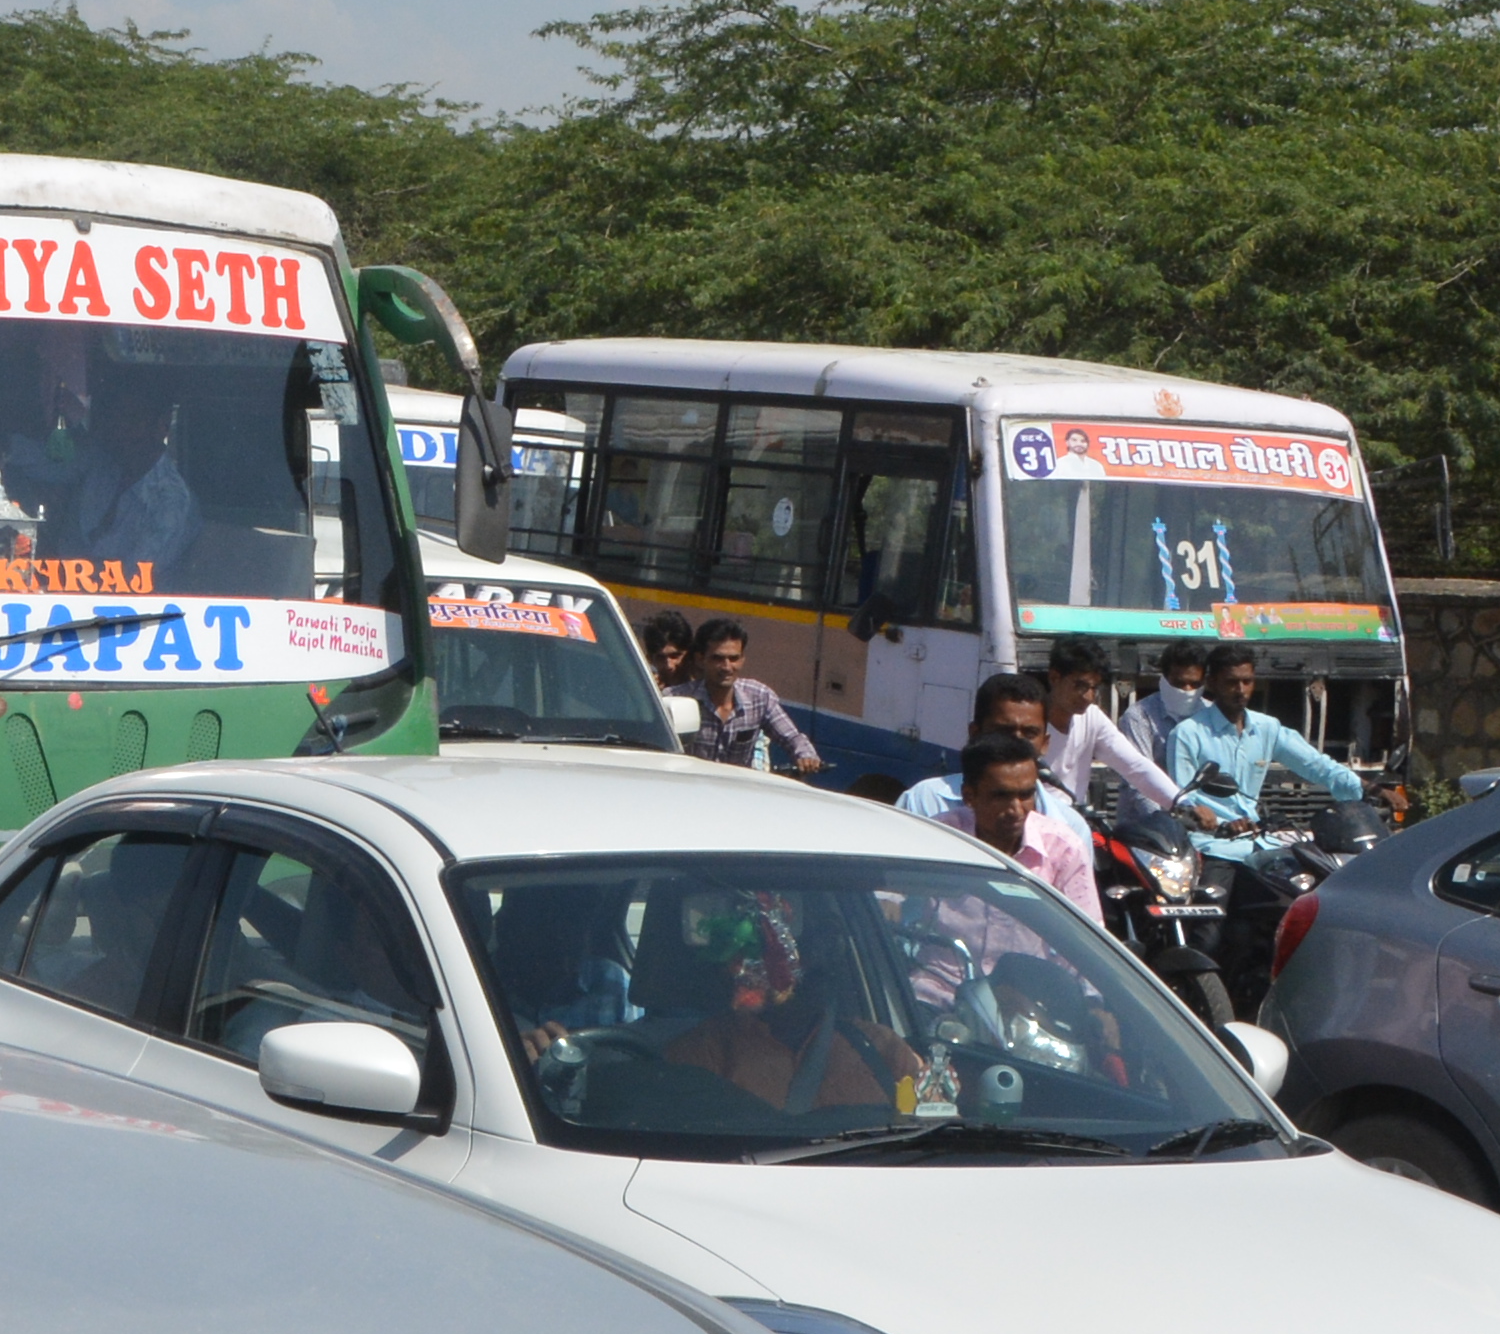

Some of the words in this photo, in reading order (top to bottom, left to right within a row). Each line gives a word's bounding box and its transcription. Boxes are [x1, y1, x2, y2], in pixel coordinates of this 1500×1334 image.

[133, 245, 306, 330] SETH
[1020, 446, 1055, 471] 31
[1098, 436, 1228, 472] राजपाल
[1229, 437, 1319, 479] चौधरी
[1323, 461, 1346, 482] 31
[1176, 540, 1220, 590] 31
[286, 608, 340, 633] Parwati
[342, 616, 378, 640] Pooja
[288, 631, 326, 653] Kajol
[329, 634, 384, 661] Manisha
